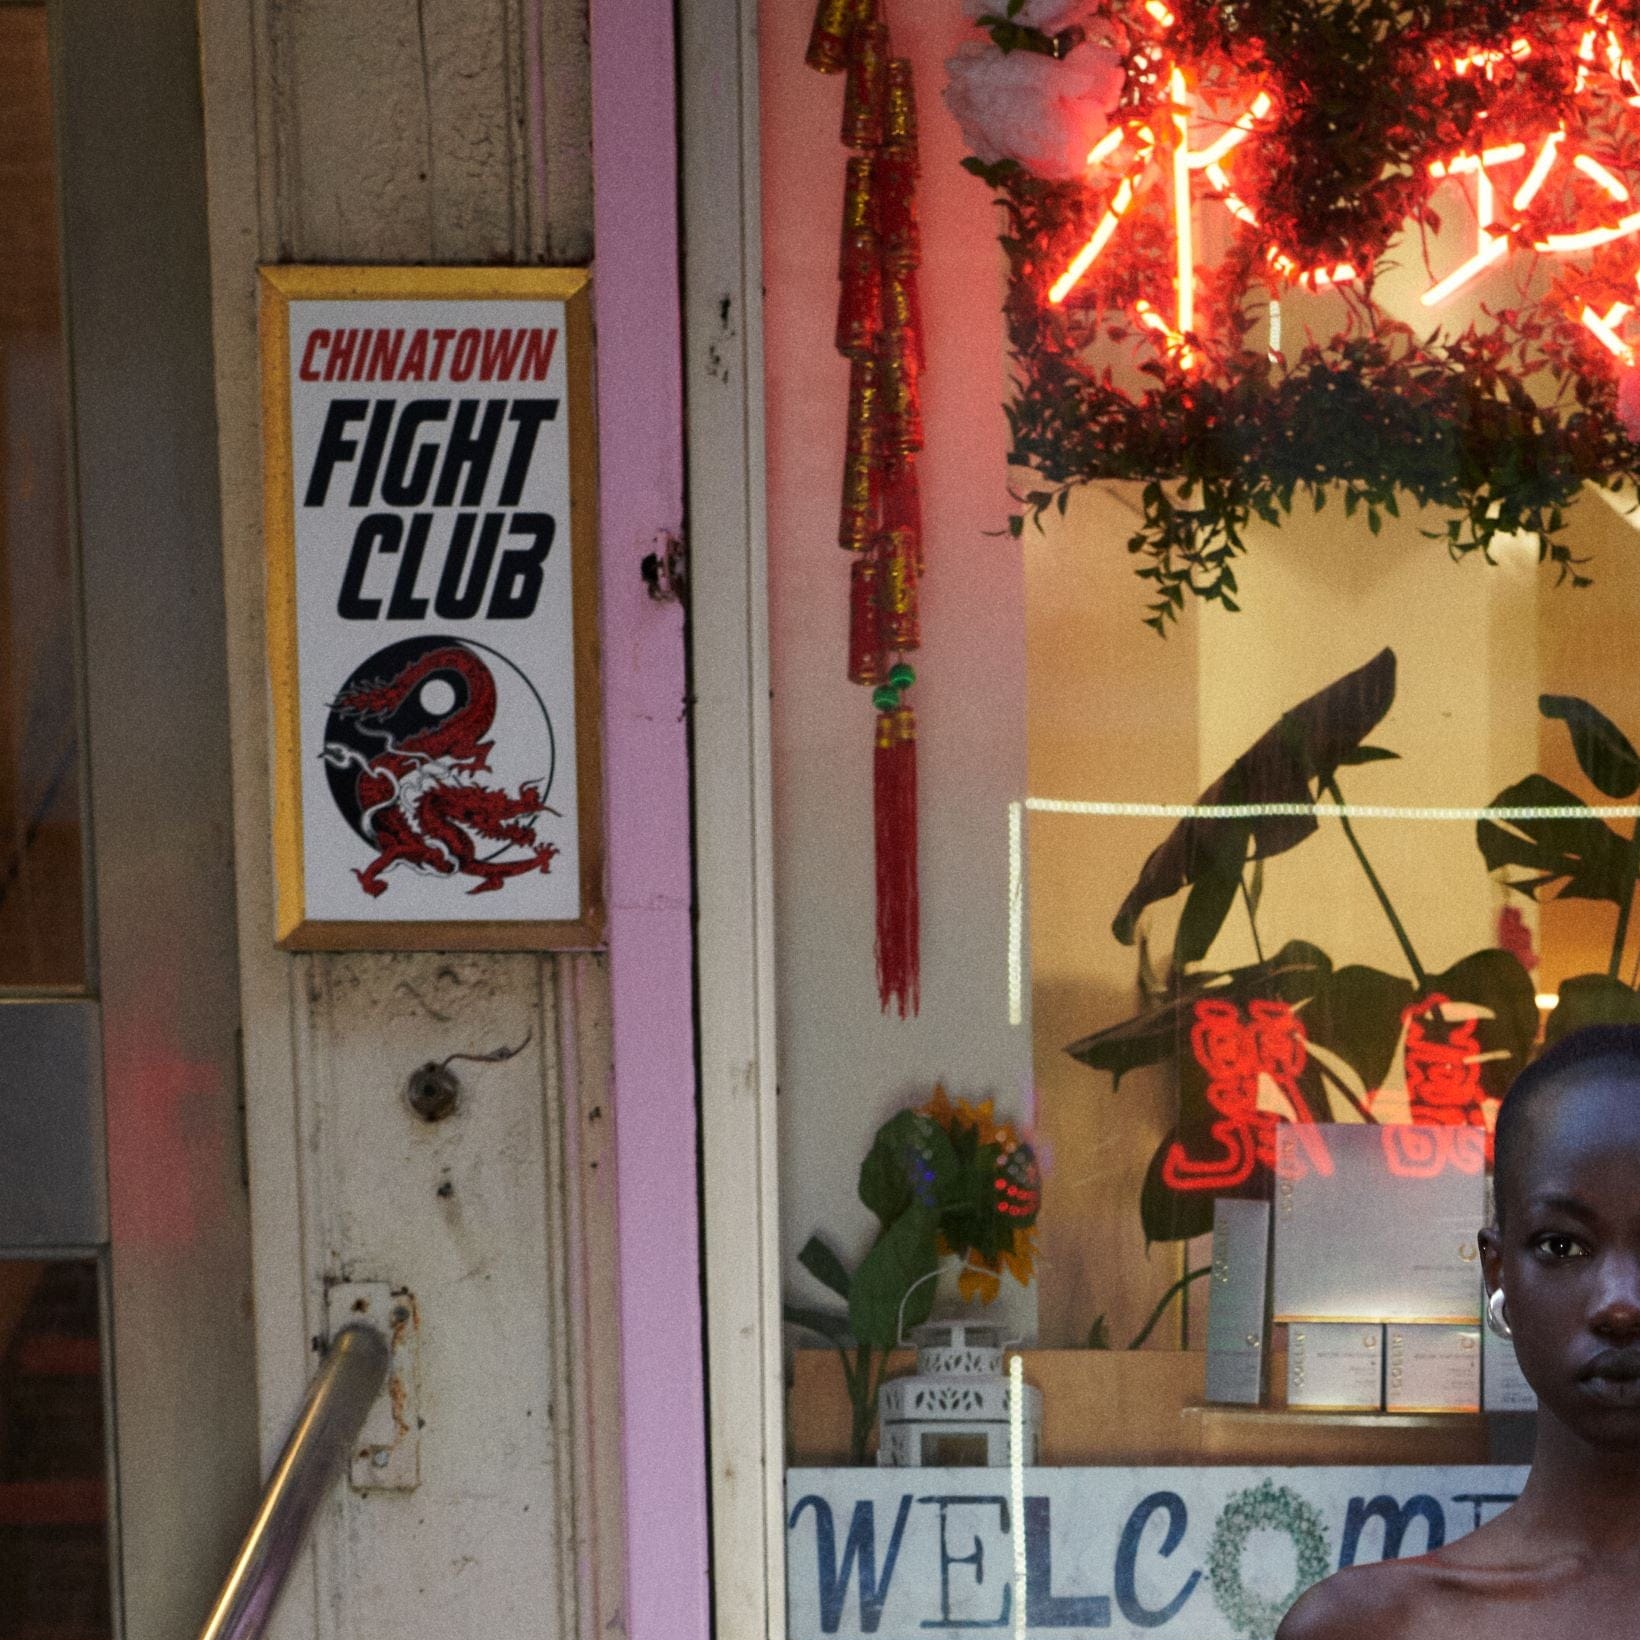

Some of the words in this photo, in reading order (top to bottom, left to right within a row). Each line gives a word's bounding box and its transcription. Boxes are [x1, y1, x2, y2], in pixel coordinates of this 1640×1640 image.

[301, 329, 557, 382] CHINATOWN
[303, 398, 560, 508] FIGHT
[336, 511, 557, 621] CLUB
[788, 1480, 1520, 1640] WELCOM
